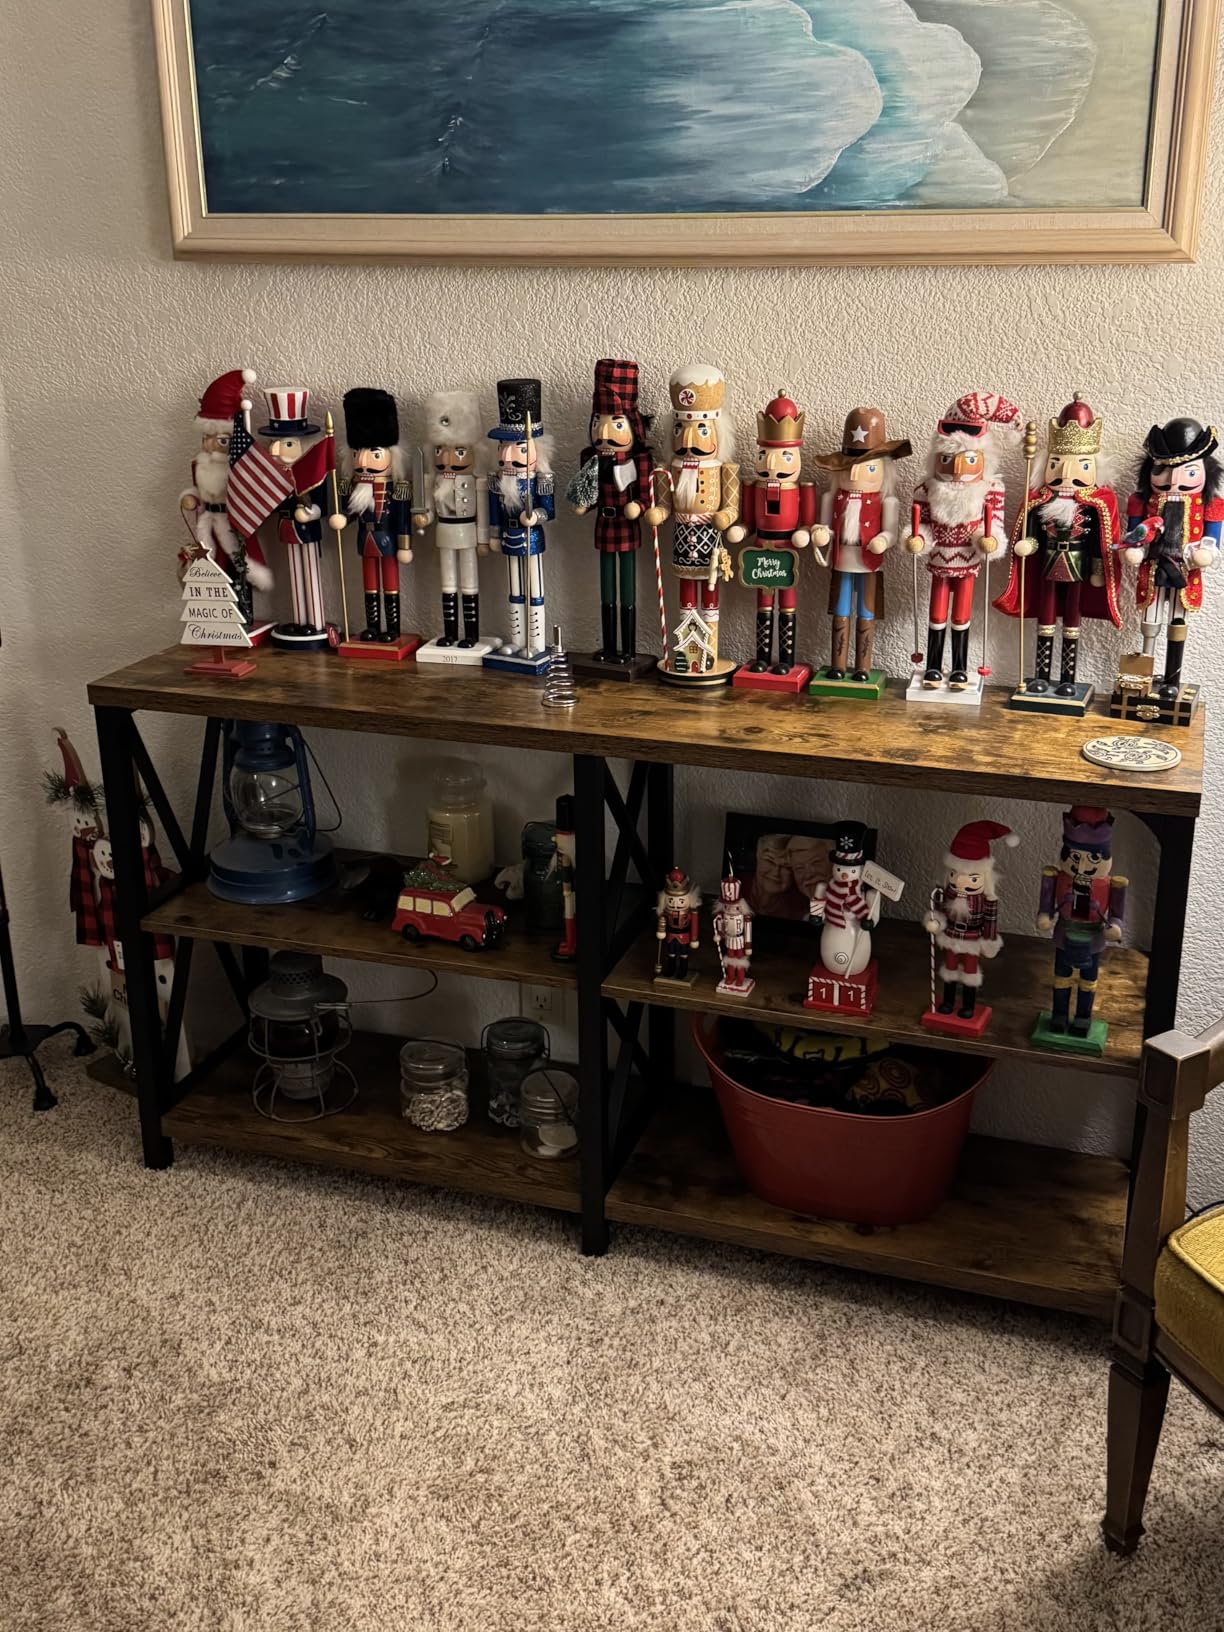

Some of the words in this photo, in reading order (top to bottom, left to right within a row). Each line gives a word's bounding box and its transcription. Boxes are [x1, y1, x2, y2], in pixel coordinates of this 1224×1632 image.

[756, 556, 781, 570] Merry
[189, 566, 222, 578] Believe
[751, 567, 788, 580] Christmas
[189, 586, 202, 598] IN
[207, 586, 229, 598] THE
[188, 607, 218, 619] MAGIC
[221, 608, 234, 619] OF
[188, 623, 243, 641] Christmas
[819, 987, 826, 999] 1
[847, 990, 854, 1002] 1
